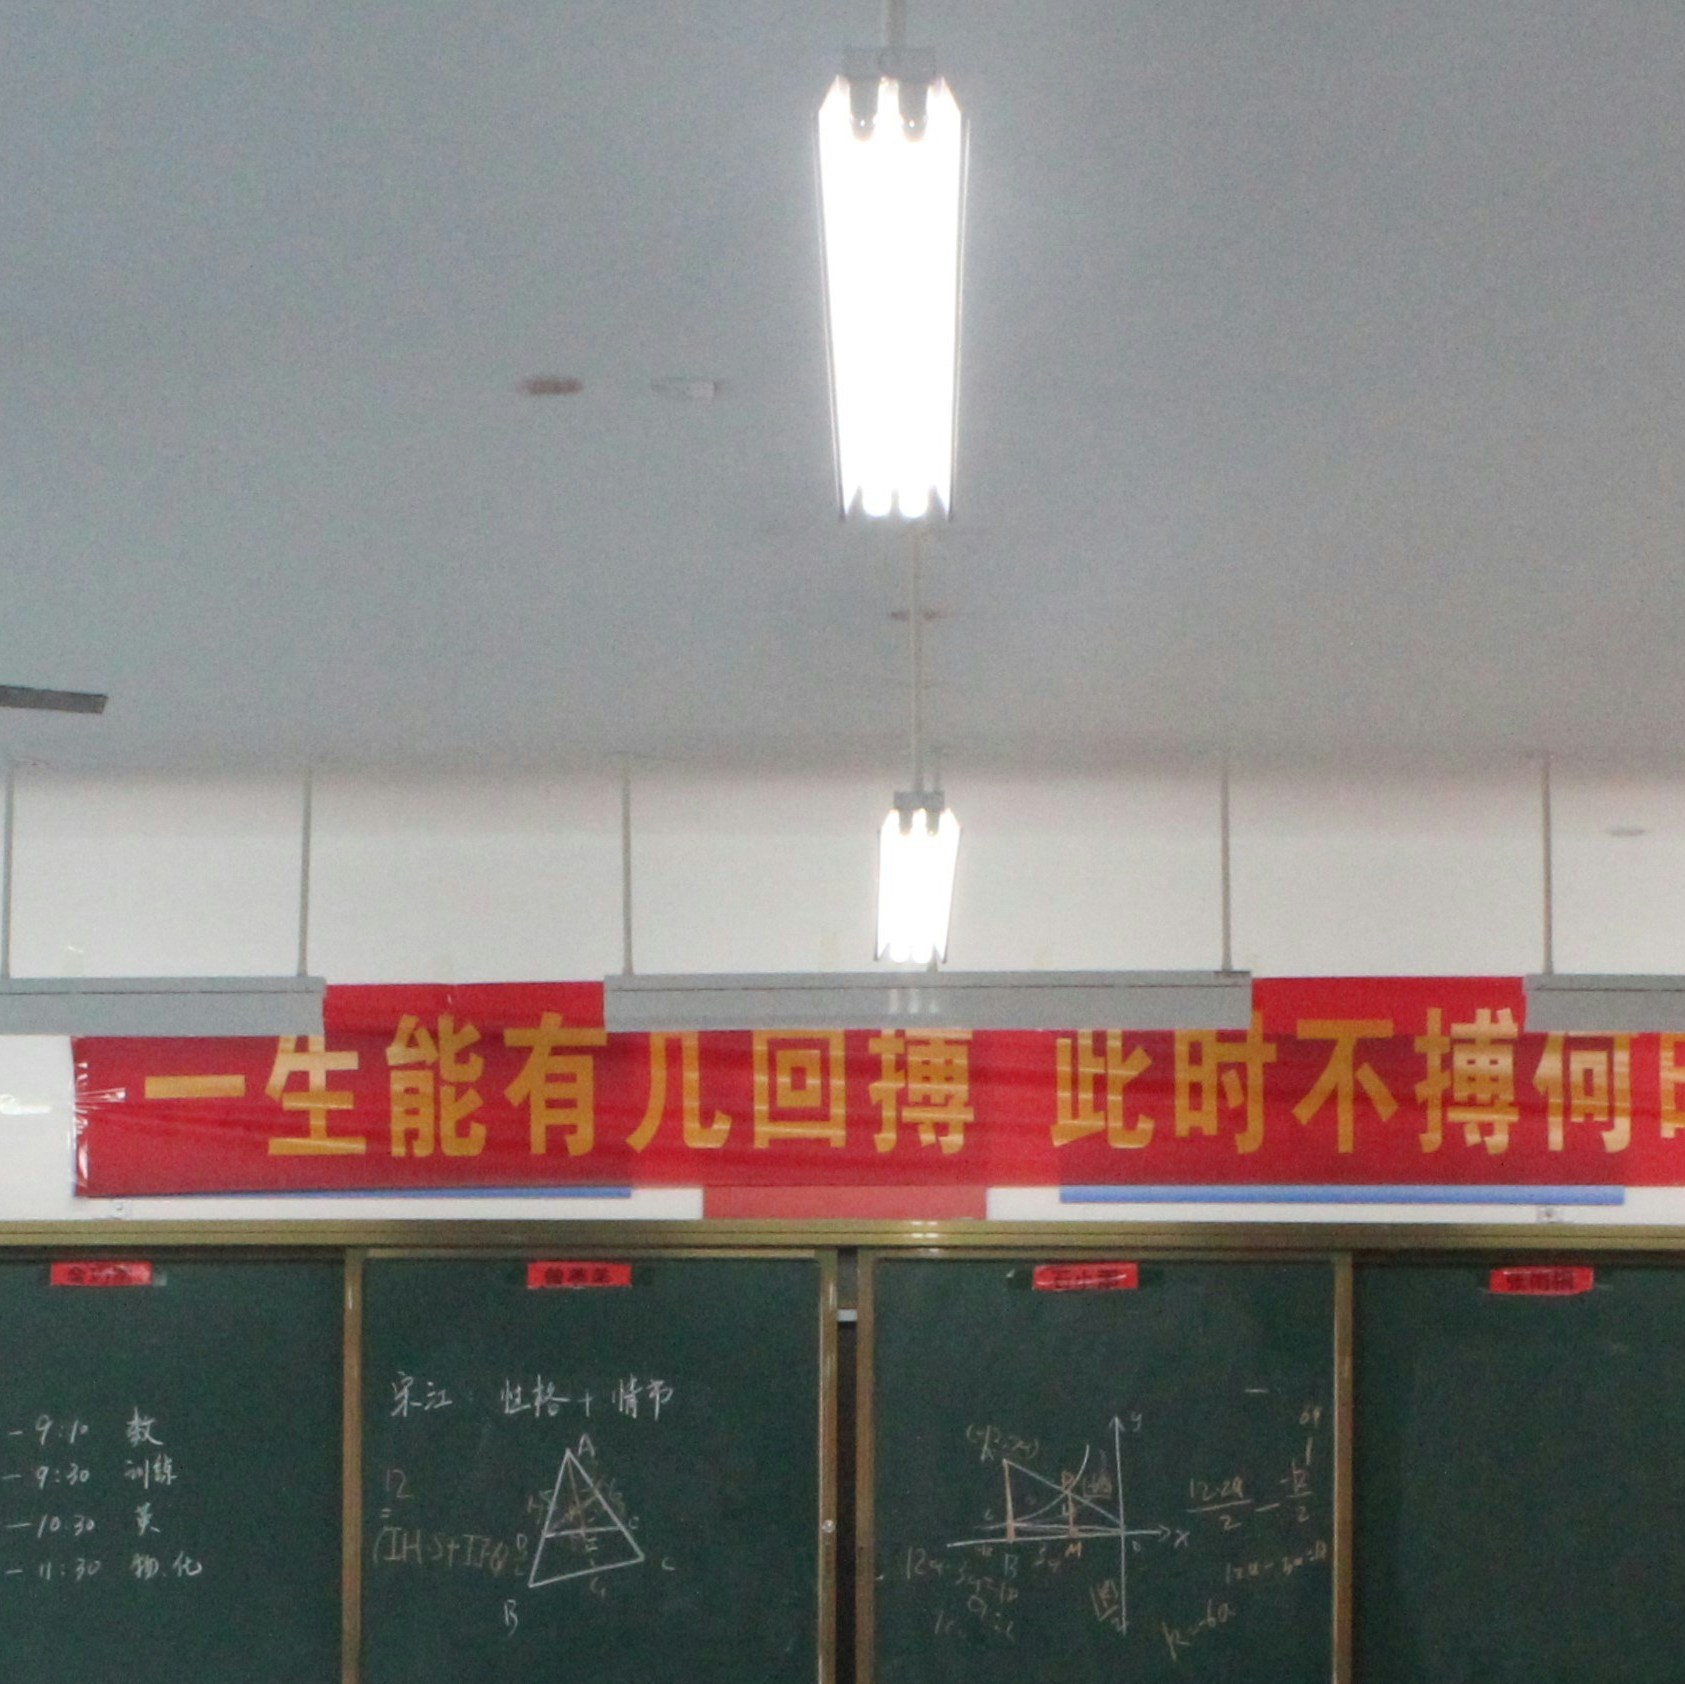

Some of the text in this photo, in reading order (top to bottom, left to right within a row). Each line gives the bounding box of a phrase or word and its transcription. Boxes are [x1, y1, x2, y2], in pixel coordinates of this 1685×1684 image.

[143, 1012, 975, 1157] 一生能有几回搏
